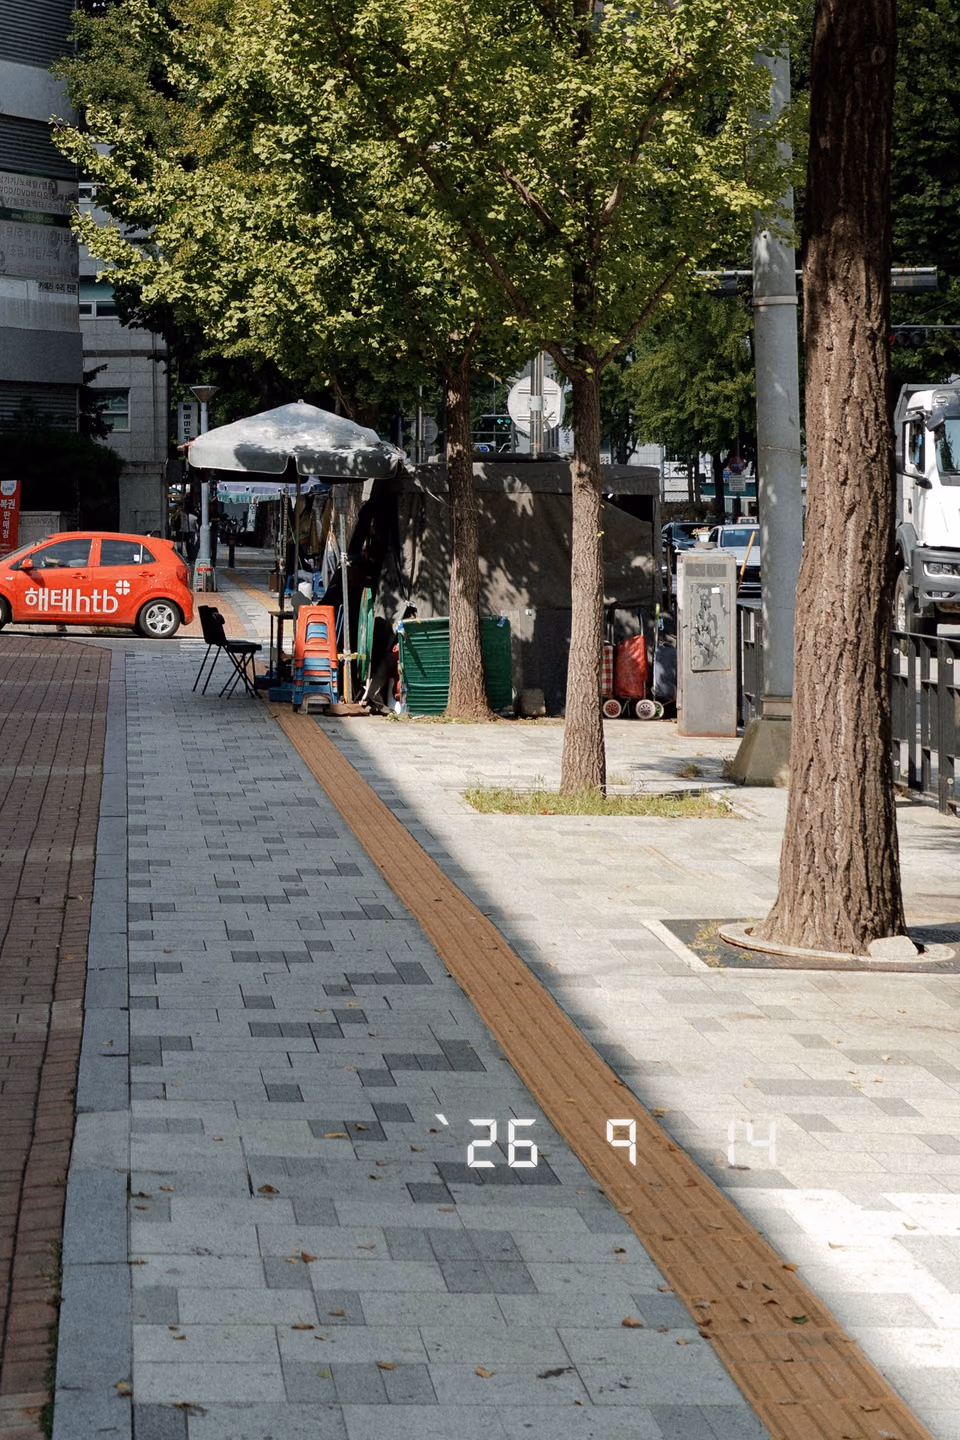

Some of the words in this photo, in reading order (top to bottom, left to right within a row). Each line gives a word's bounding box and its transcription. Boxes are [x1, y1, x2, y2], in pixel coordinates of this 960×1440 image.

[0, 498, 16, 510] 복권
[1, 510, 11, 539] 판매점
[24, 587, 119, 614] 해태htb
